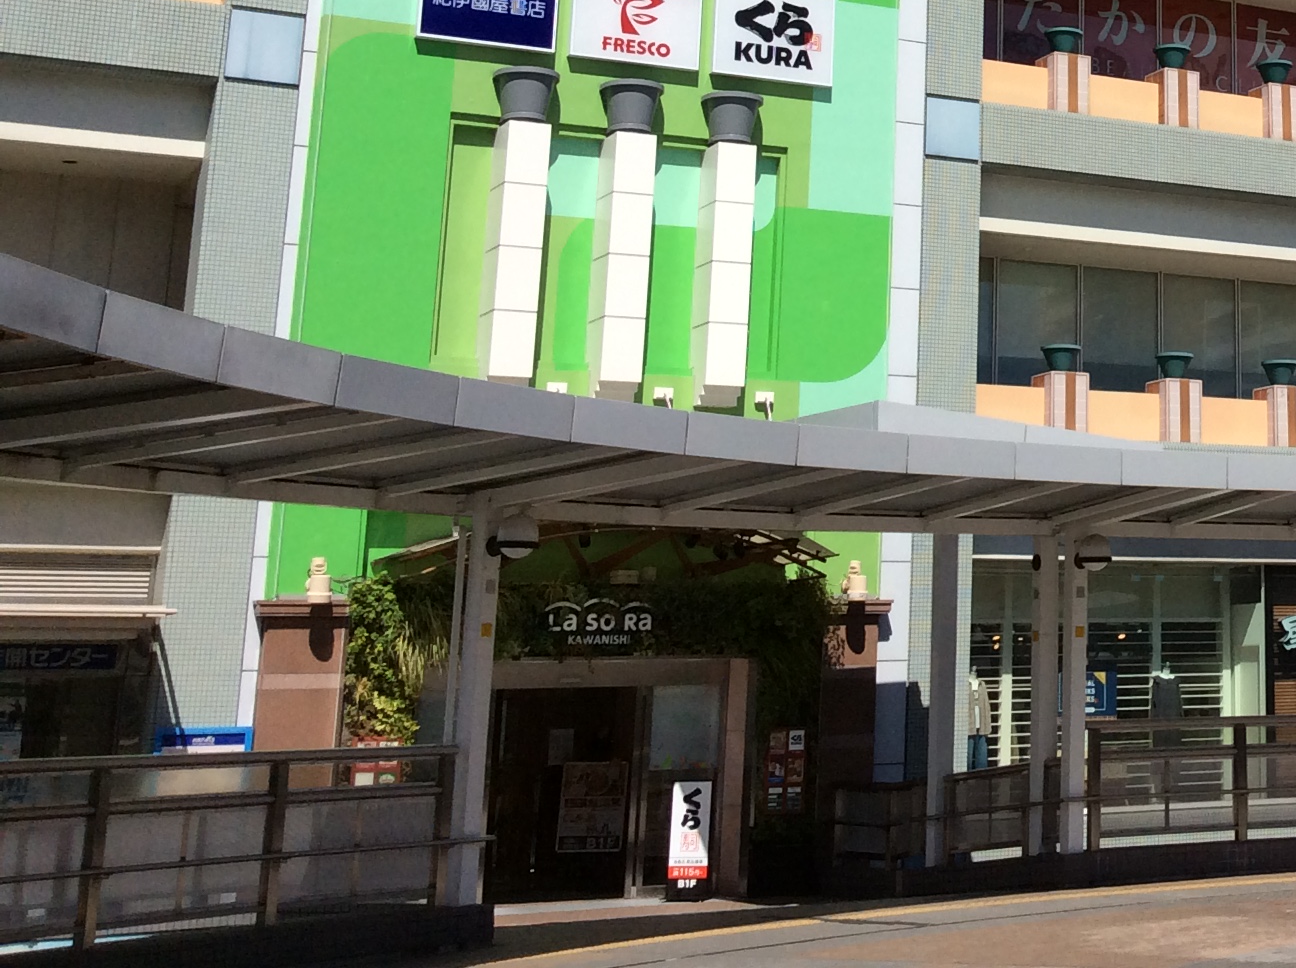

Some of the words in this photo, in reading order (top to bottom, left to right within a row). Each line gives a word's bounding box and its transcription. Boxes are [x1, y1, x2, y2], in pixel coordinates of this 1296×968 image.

[734, 0, 814, 47] くら
[602, 35, 671, 58] FRESCO
[734, 41, 813, 71] KURA
[567, 634, 631, 645] KAWANISHI
[681, 787, 702, 830] くら
[677, 879, 697, 889] B1F
